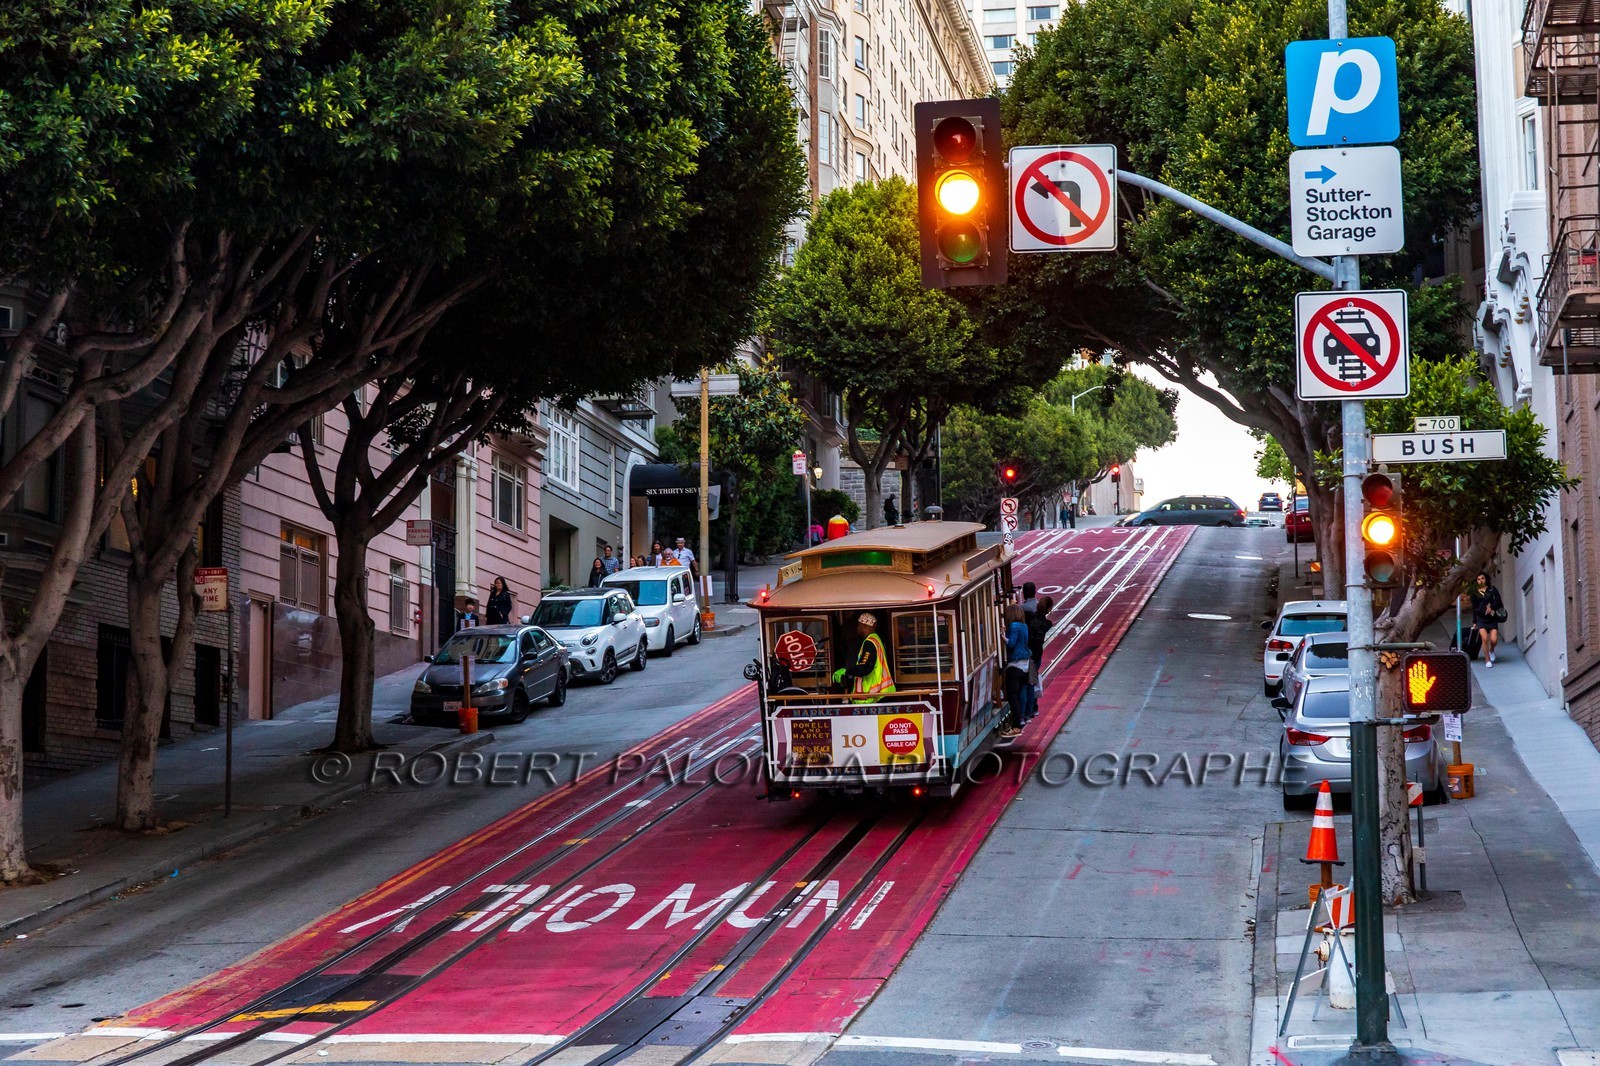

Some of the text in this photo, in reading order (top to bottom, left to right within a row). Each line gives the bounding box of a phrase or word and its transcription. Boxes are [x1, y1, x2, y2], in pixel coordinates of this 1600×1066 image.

[1305, 187, 1371, 204] Sutter-
[1305, 205, 1393, 223] Stockton
[1307, 224, 1376, 242] Garage
[1430, 418, 1456, 430] 700
[1401, 437, 1475, 456] BUSH
[658, 487, 684, 495] THIRTY
[194, 575, 227, 584] NO STOPPING
[784, 635, 808, 669] STOP
[793, 708, 841, 717] MARKET
[853, 705, 901, 716] STREET
[841, 734, 867, 748] 10
[626, 881, 896, 931] MUNI
